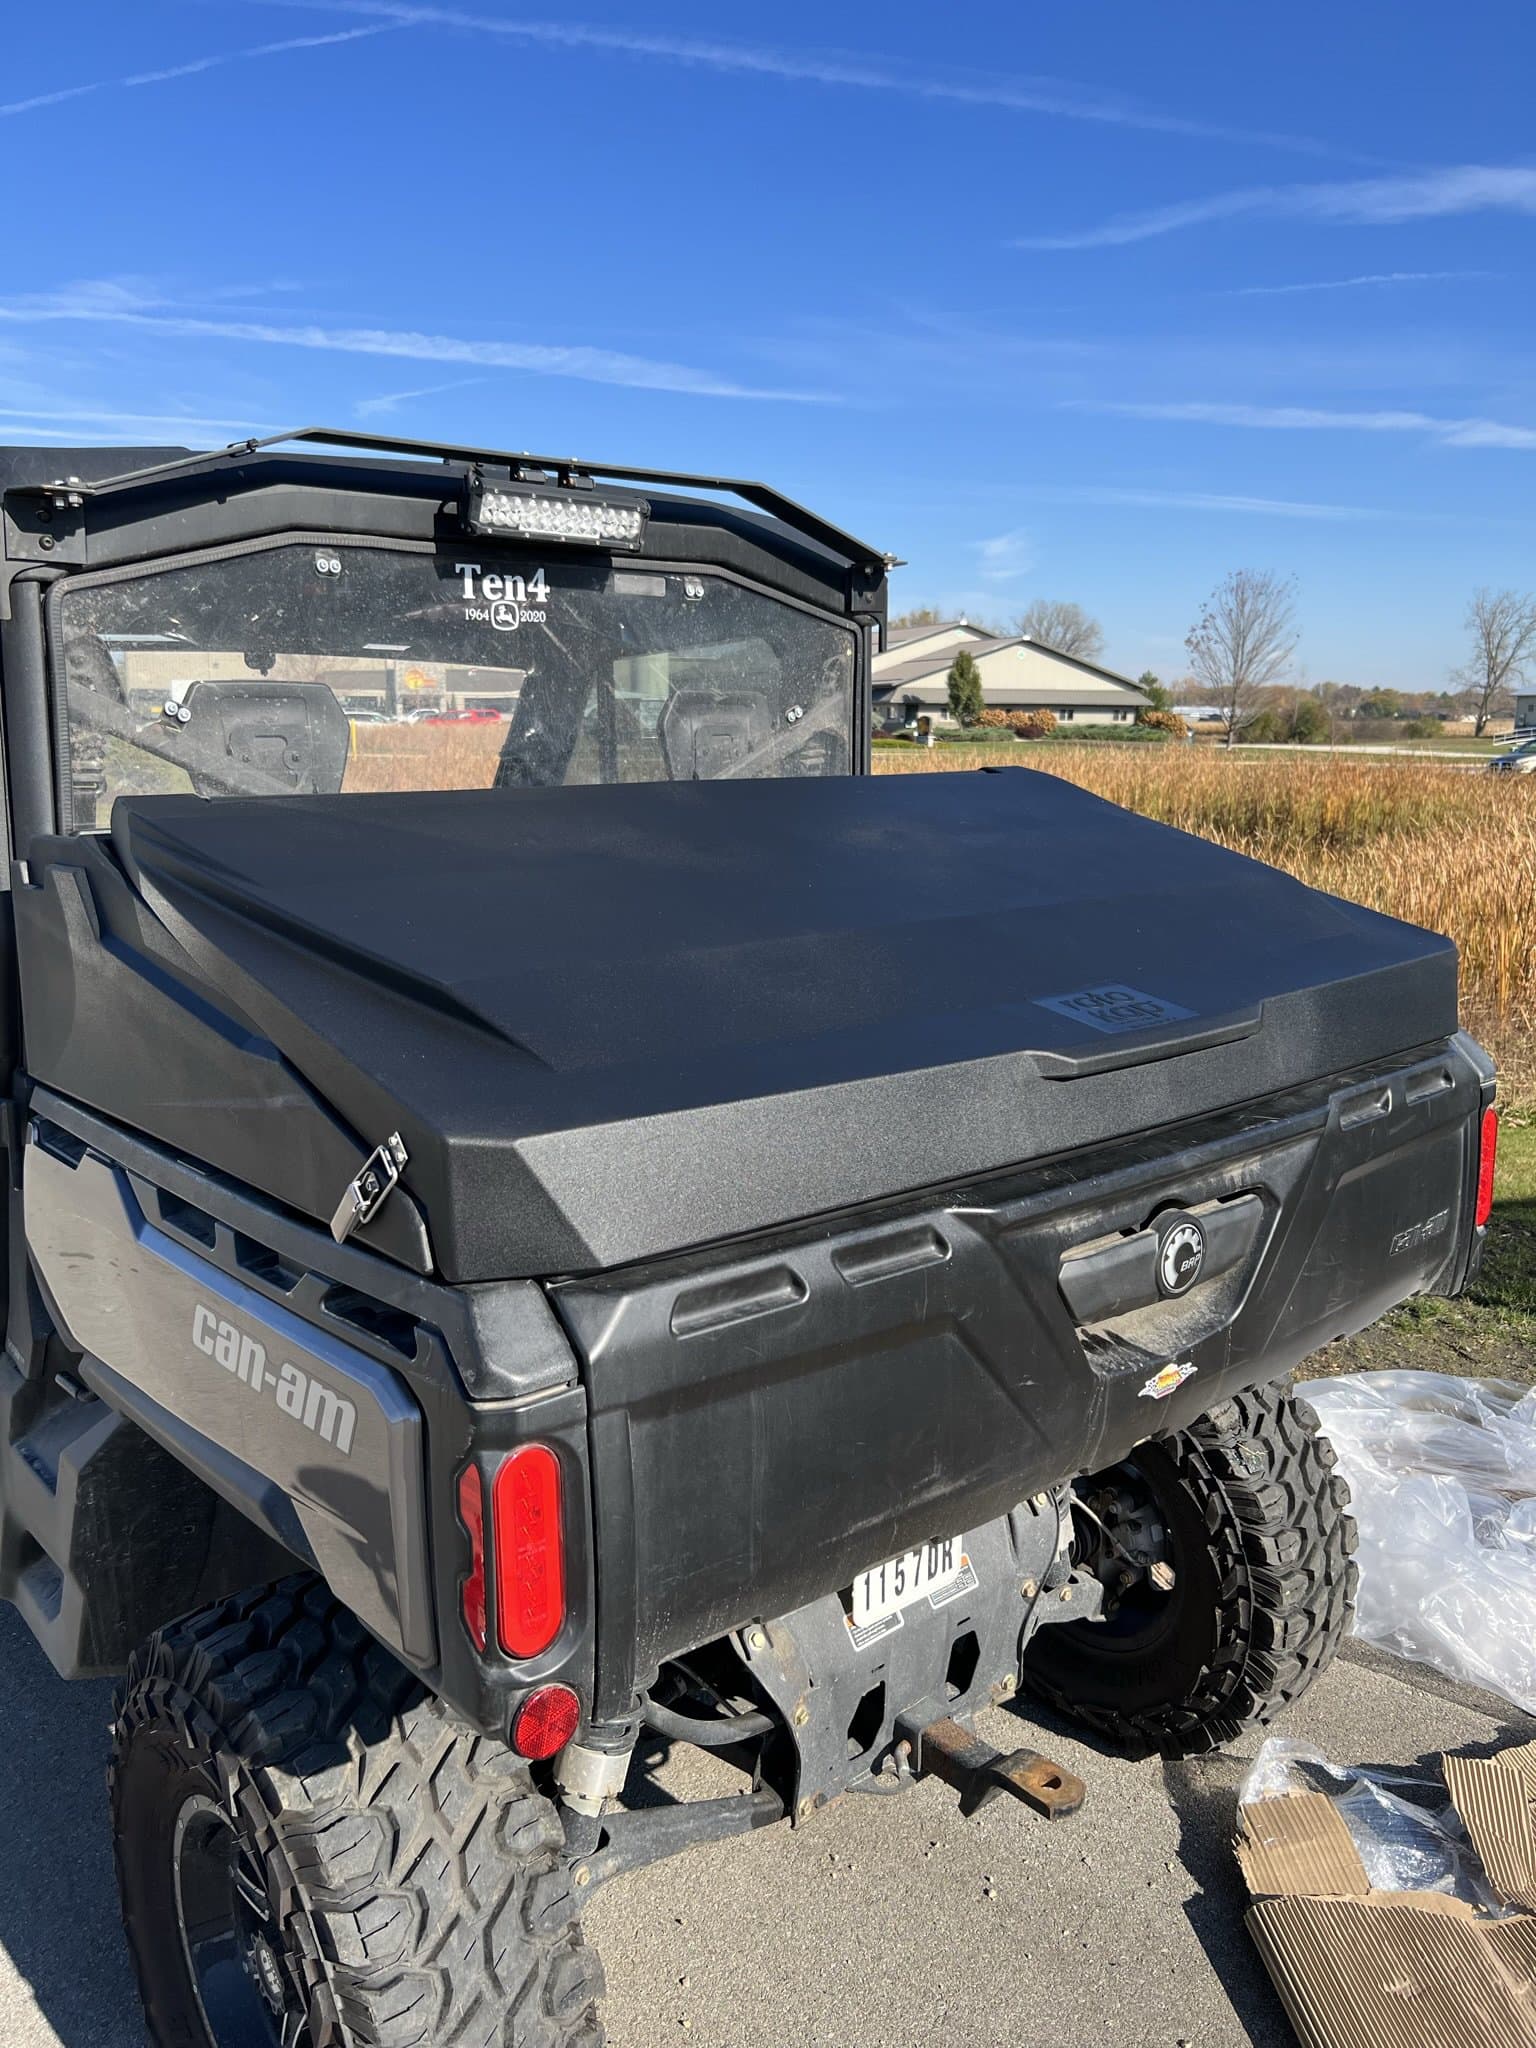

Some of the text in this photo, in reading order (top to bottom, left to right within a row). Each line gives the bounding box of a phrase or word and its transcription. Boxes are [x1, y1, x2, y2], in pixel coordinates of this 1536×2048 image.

[455, 563, 551, 602] Ten4
[464, 607, 547, 623] 1964 2020
[1180, 1252, 1201, 1273] BRP
[192, 1303, 357, 1455] can-am
